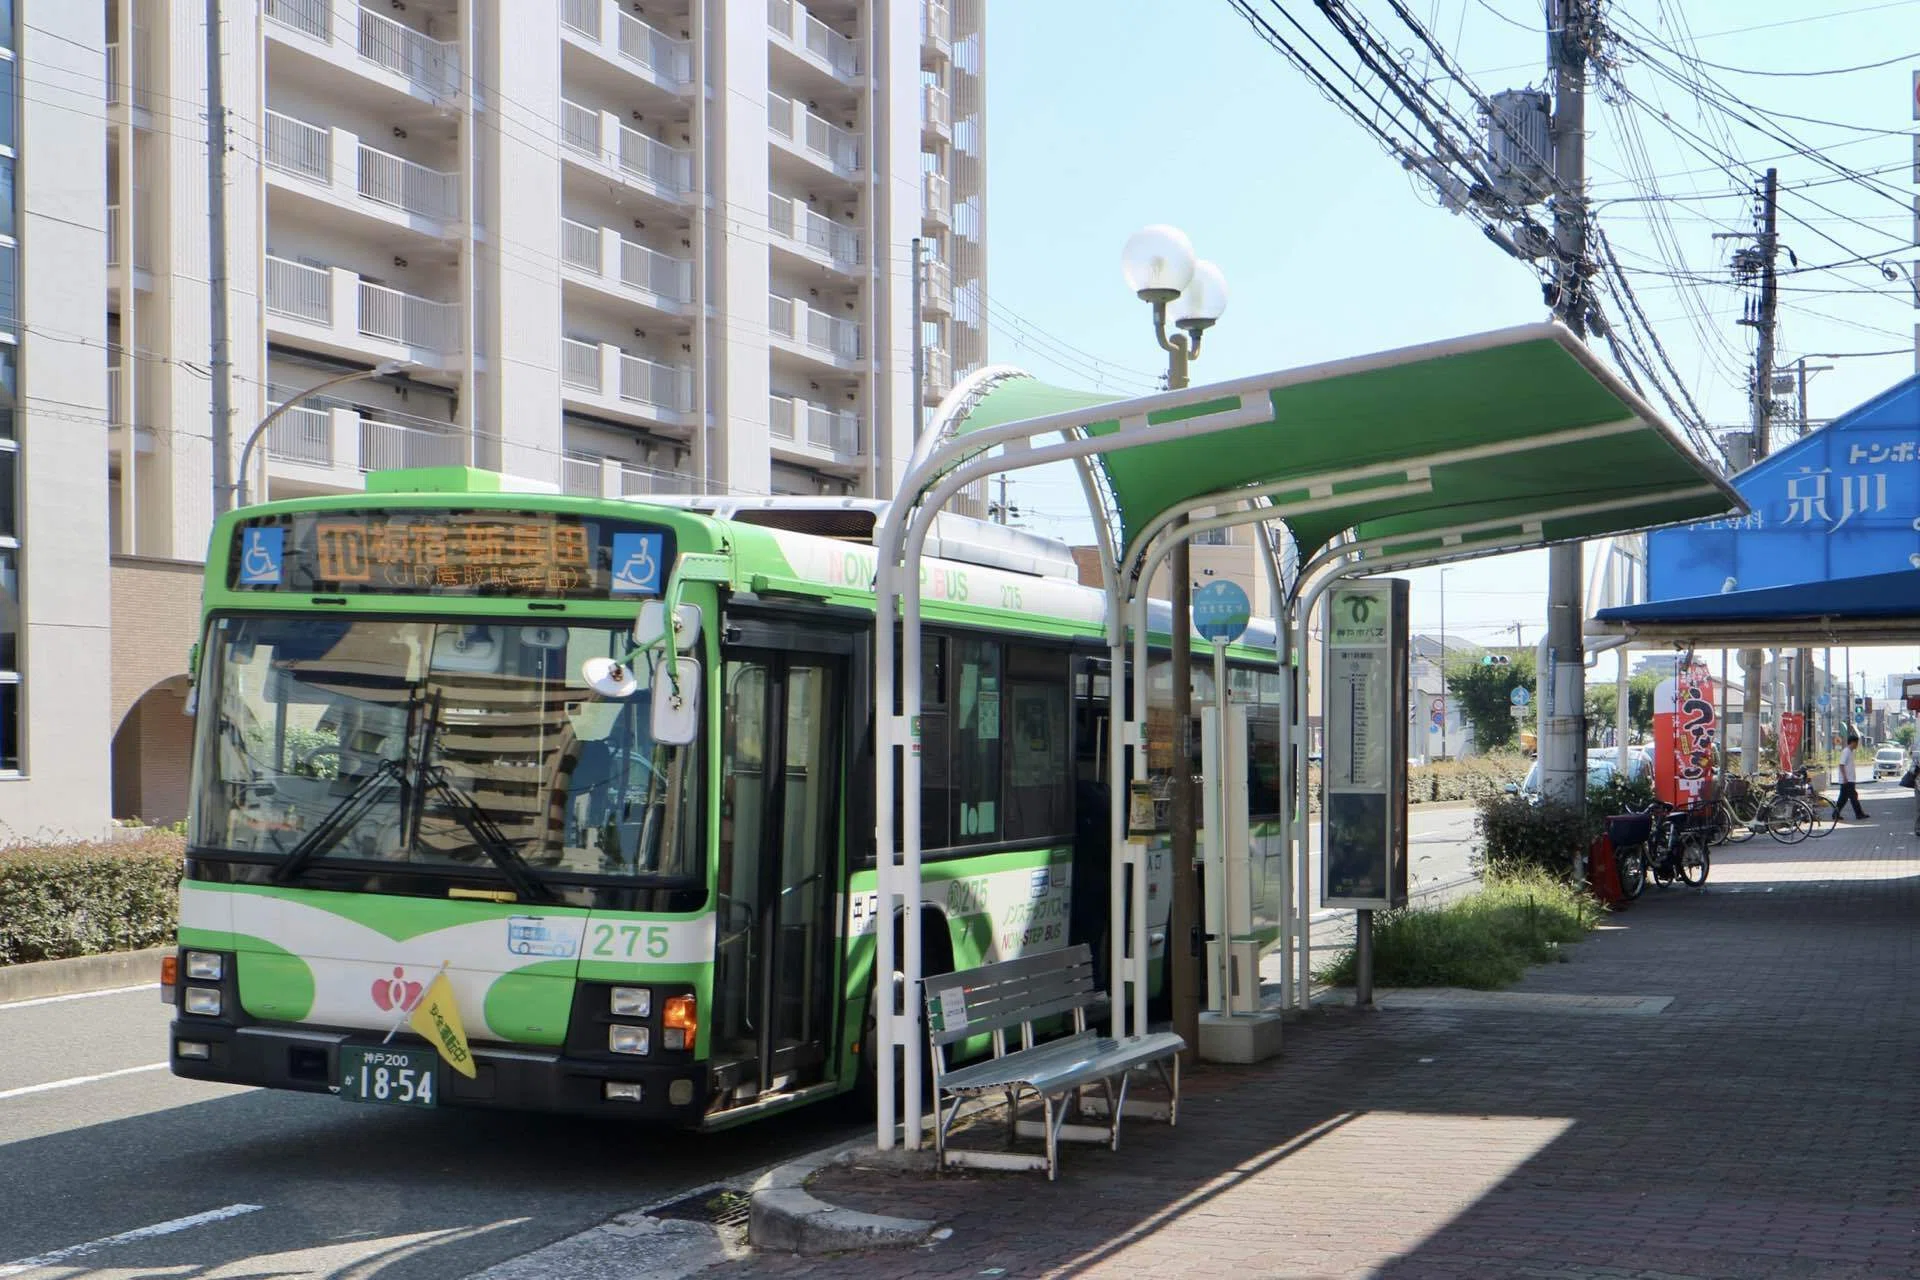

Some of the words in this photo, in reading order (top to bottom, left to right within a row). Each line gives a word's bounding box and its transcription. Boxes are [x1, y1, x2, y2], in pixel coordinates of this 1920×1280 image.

[1850, 442, 1920, 464] トンボ
[1782, 466, 1888, 534] 京川
[934, 567, 968, 601] BUS
[1001, 583, 1022, 609] 275
[593, 924, 669, 959] 275
[361, 1065, 432, 1104] 18-54
